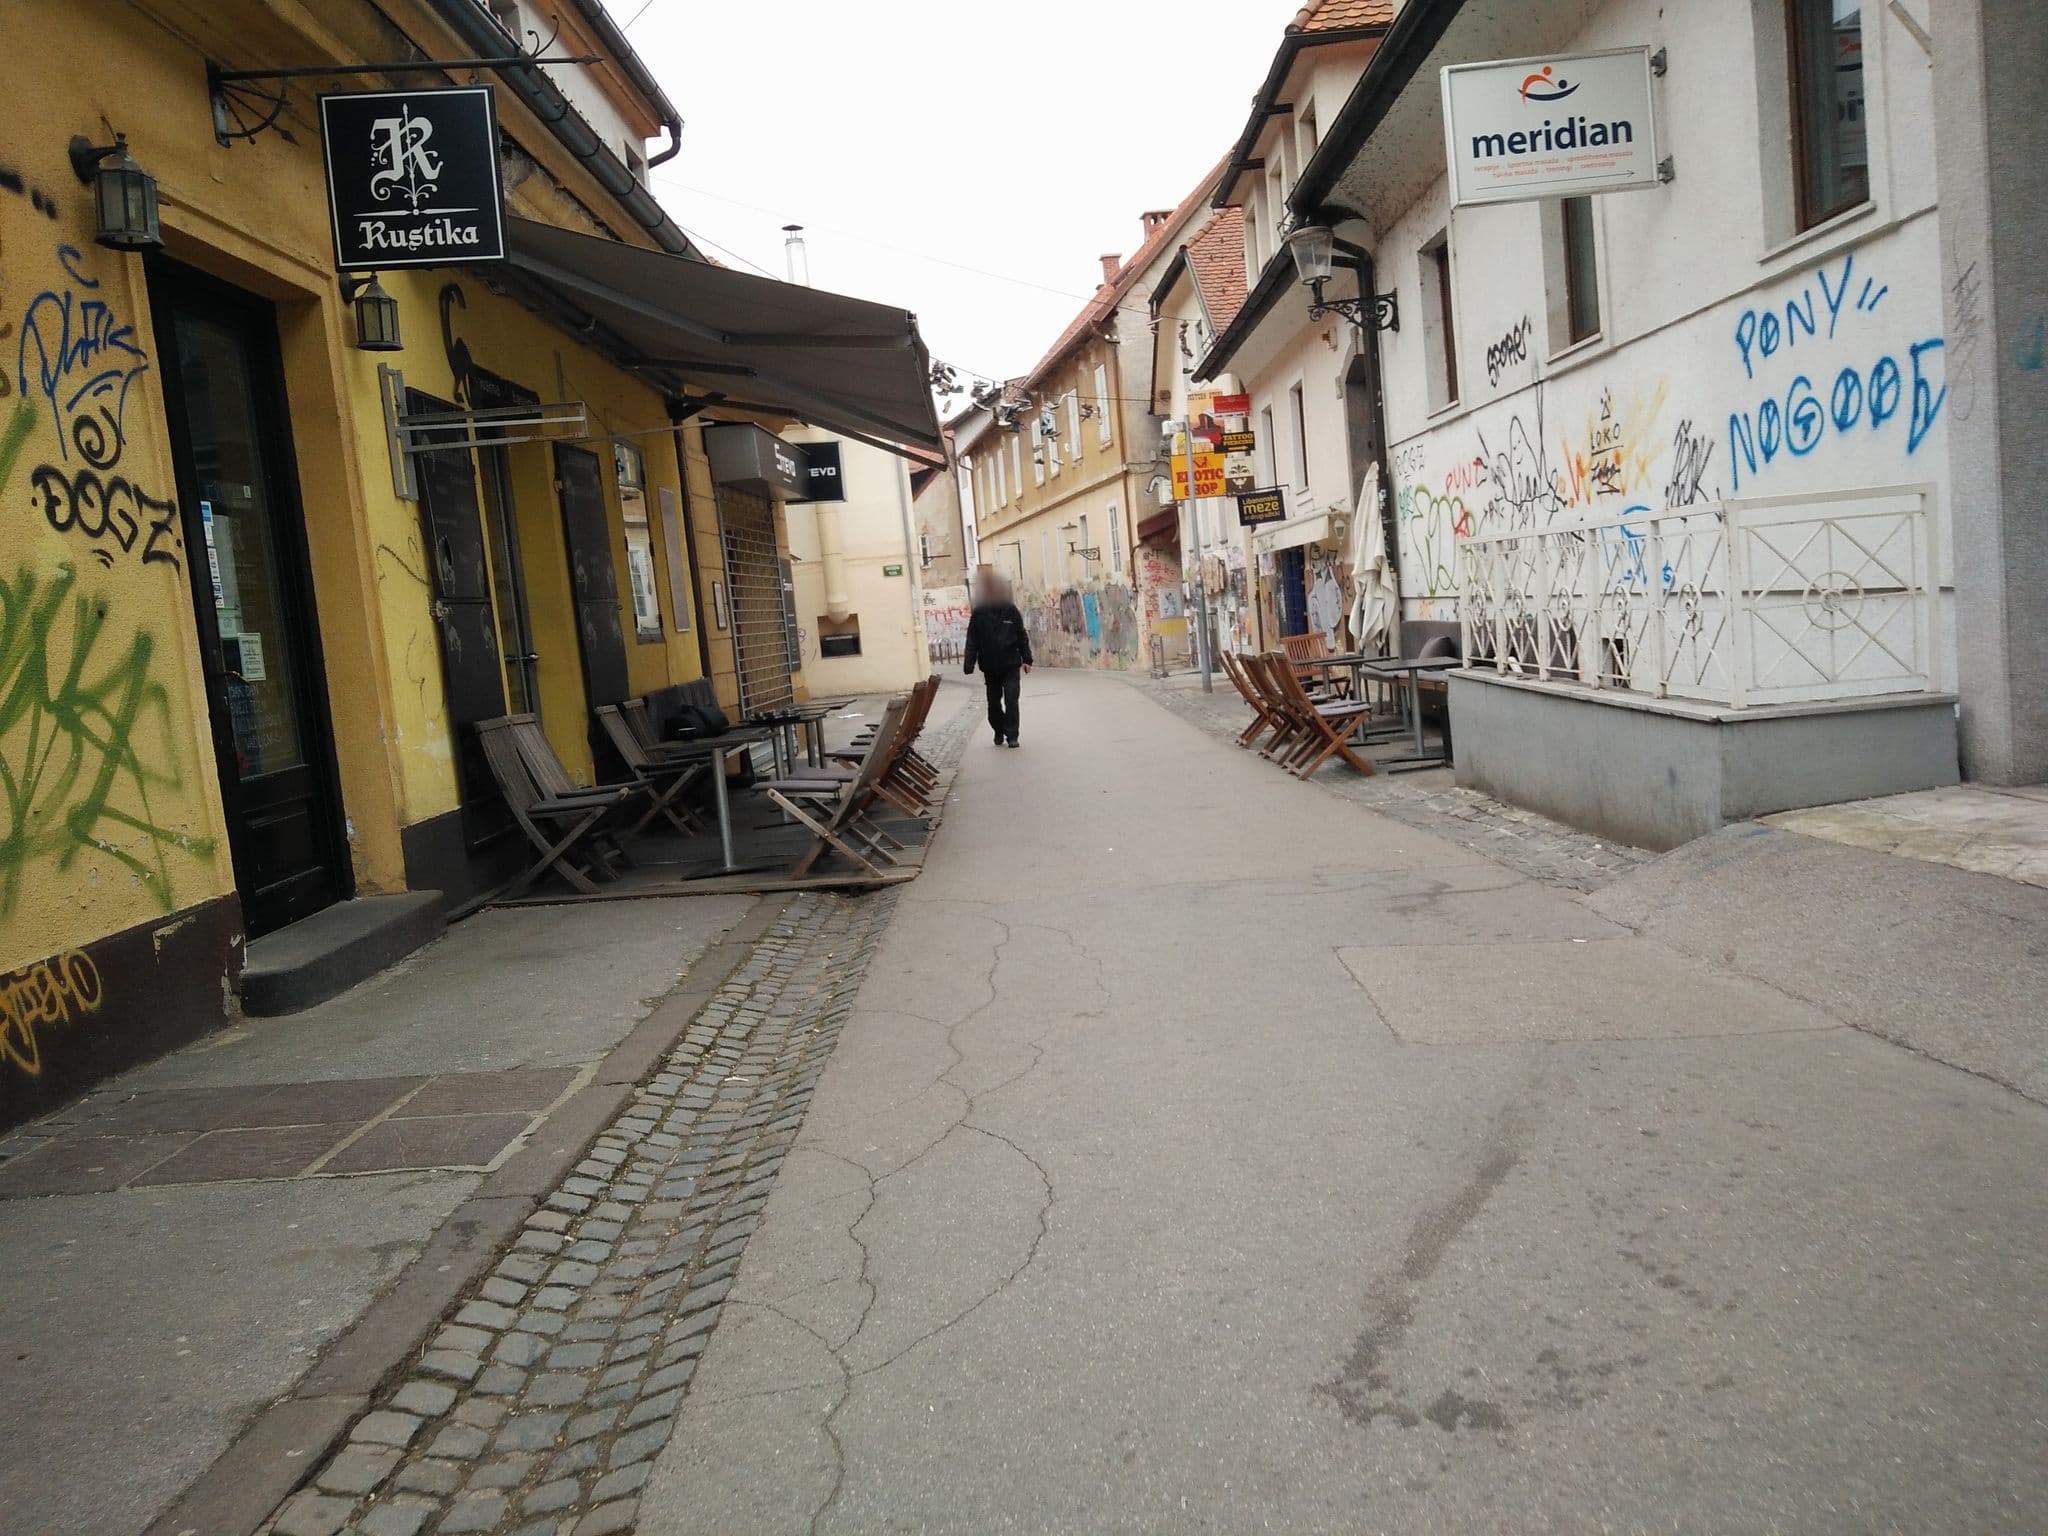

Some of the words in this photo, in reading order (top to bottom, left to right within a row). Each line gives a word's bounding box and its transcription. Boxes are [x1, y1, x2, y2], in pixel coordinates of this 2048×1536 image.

[1472, 116, 1633, 158] meridian
[358, 218, 480, 252] Rustika
[1243, 501, 1279, 515] meze
